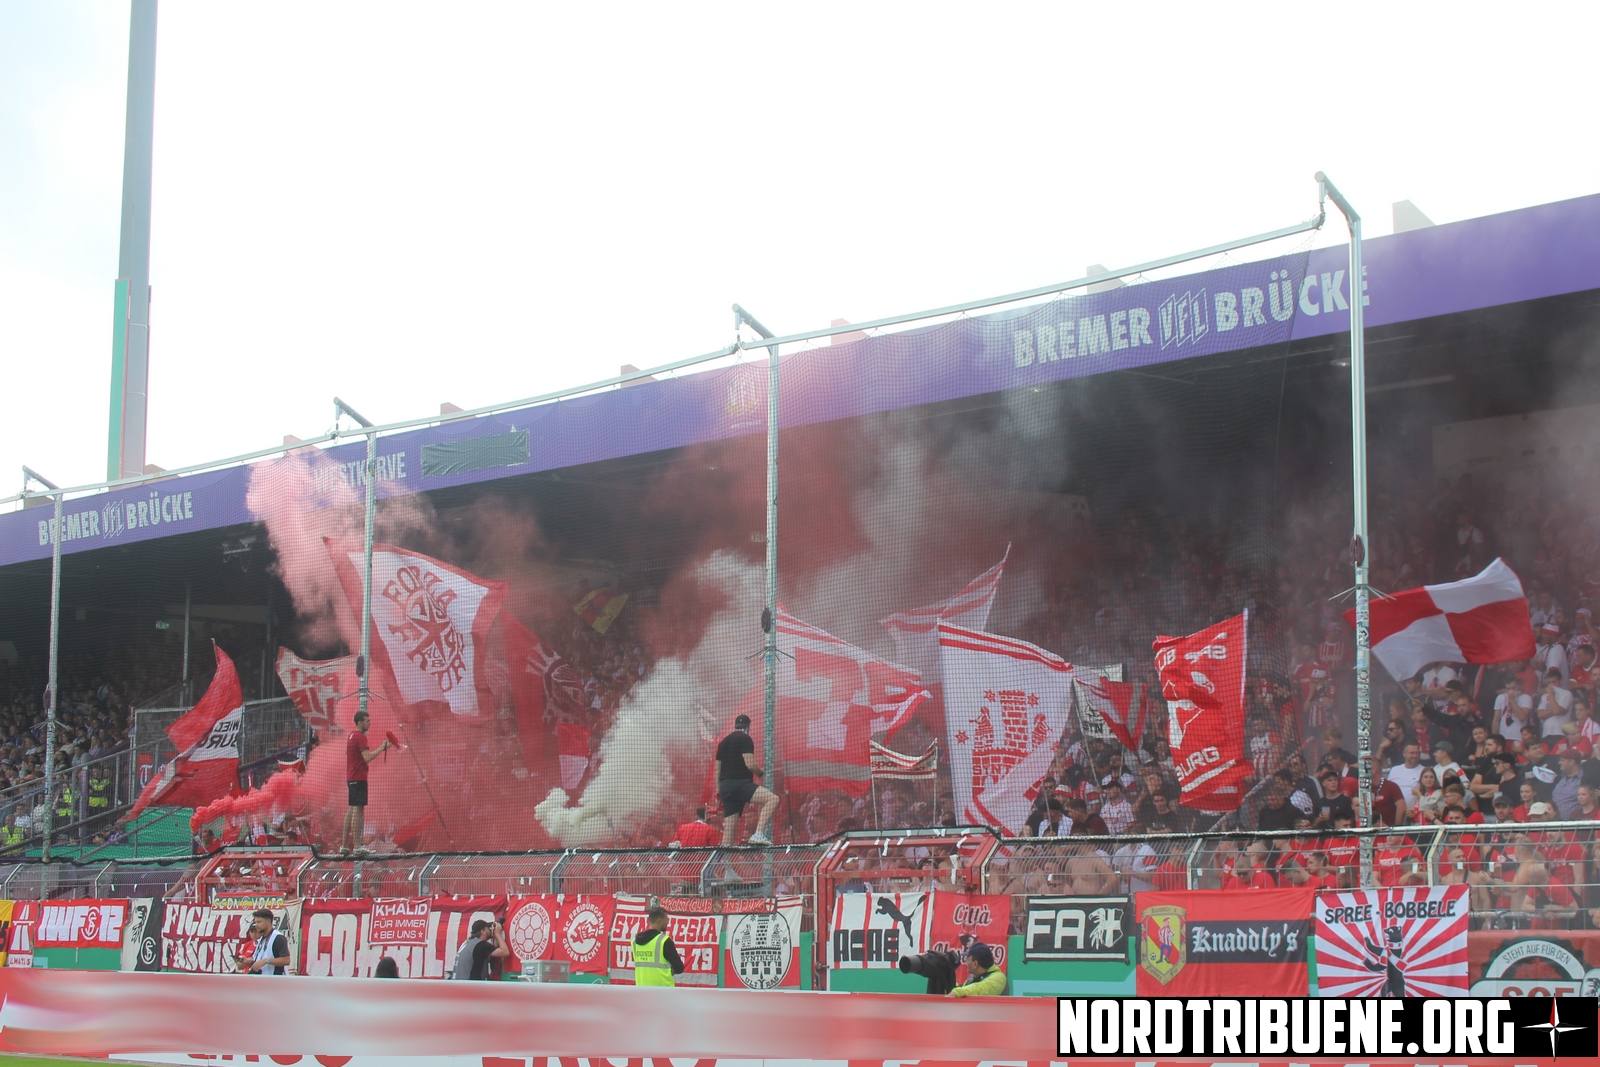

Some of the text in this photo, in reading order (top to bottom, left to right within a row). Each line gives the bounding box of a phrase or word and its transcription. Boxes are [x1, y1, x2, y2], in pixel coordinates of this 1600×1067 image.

[1013, 307, 1153, 368] BREMER
[126, 491, 194, 530] BRÜCKE
[375, 902, 428, 917] KHALID
[512, 903, 549, 925] FUSSBALL MUSS
[659, 897, 765, 913] SPORT CLUB FREIBURG
[953, 902, 993, 927] Città
[1324, 904, 1373, 924] SPREE
[1384, 900, 1457, 919] BOBBELE
[163, 903, 233, 938] FIGHT
[374, 919, 426, 928] FÜR IMMER
[563, 920, 571, 931] SC
[612, 914, 718, 943] SYNHESIA
[380, 930, 416, 939] BEI UNS
[537, 938, 547, 954] SEIN
[1191, 922, 1300, 958] Knaddly's
[162, 936, 246, 974] FASCIS
[562, 938, 602, 963] GEGEN RECHTS
[691, 947, 713, 971] 79
[1502, 944, 1571, 965] STEHT AUF FÜR DEN
